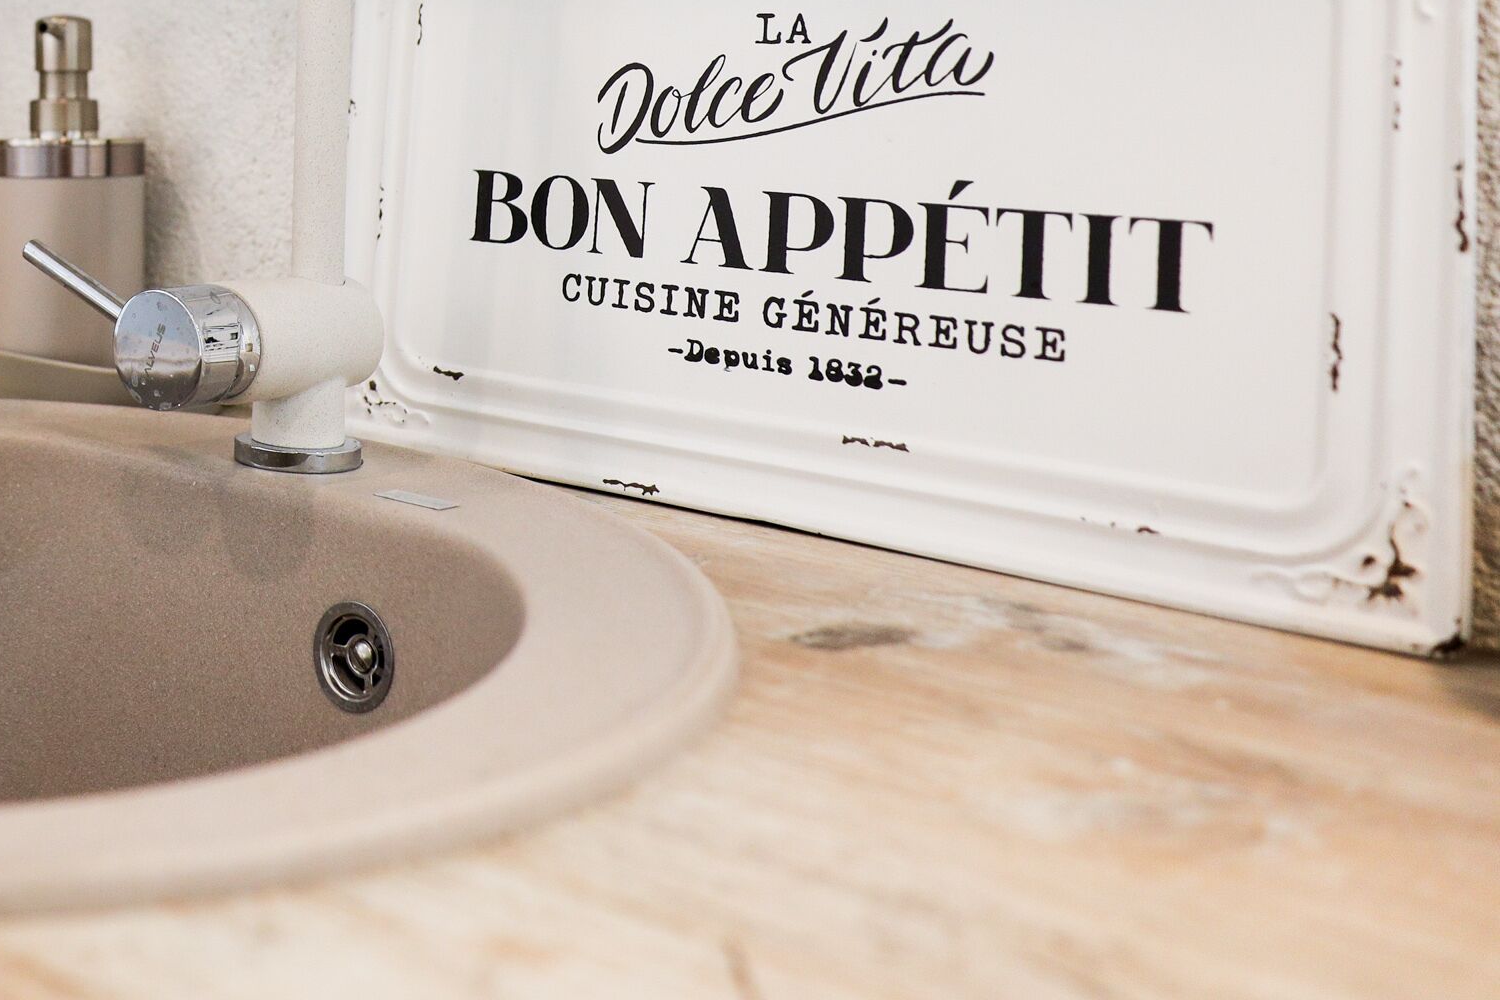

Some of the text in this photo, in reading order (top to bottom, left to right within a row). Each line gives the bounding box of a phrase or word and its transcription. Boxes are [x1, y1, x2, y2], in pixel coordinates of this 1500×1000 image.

[596, 16, 995, 155] Dolce Vita
[754, 12, 812, 45] LA
[469, 169, 1214, 313] BON APPÉTIT
[562, 273, 1066, 363] CUISINE GÉNÉREUSE
